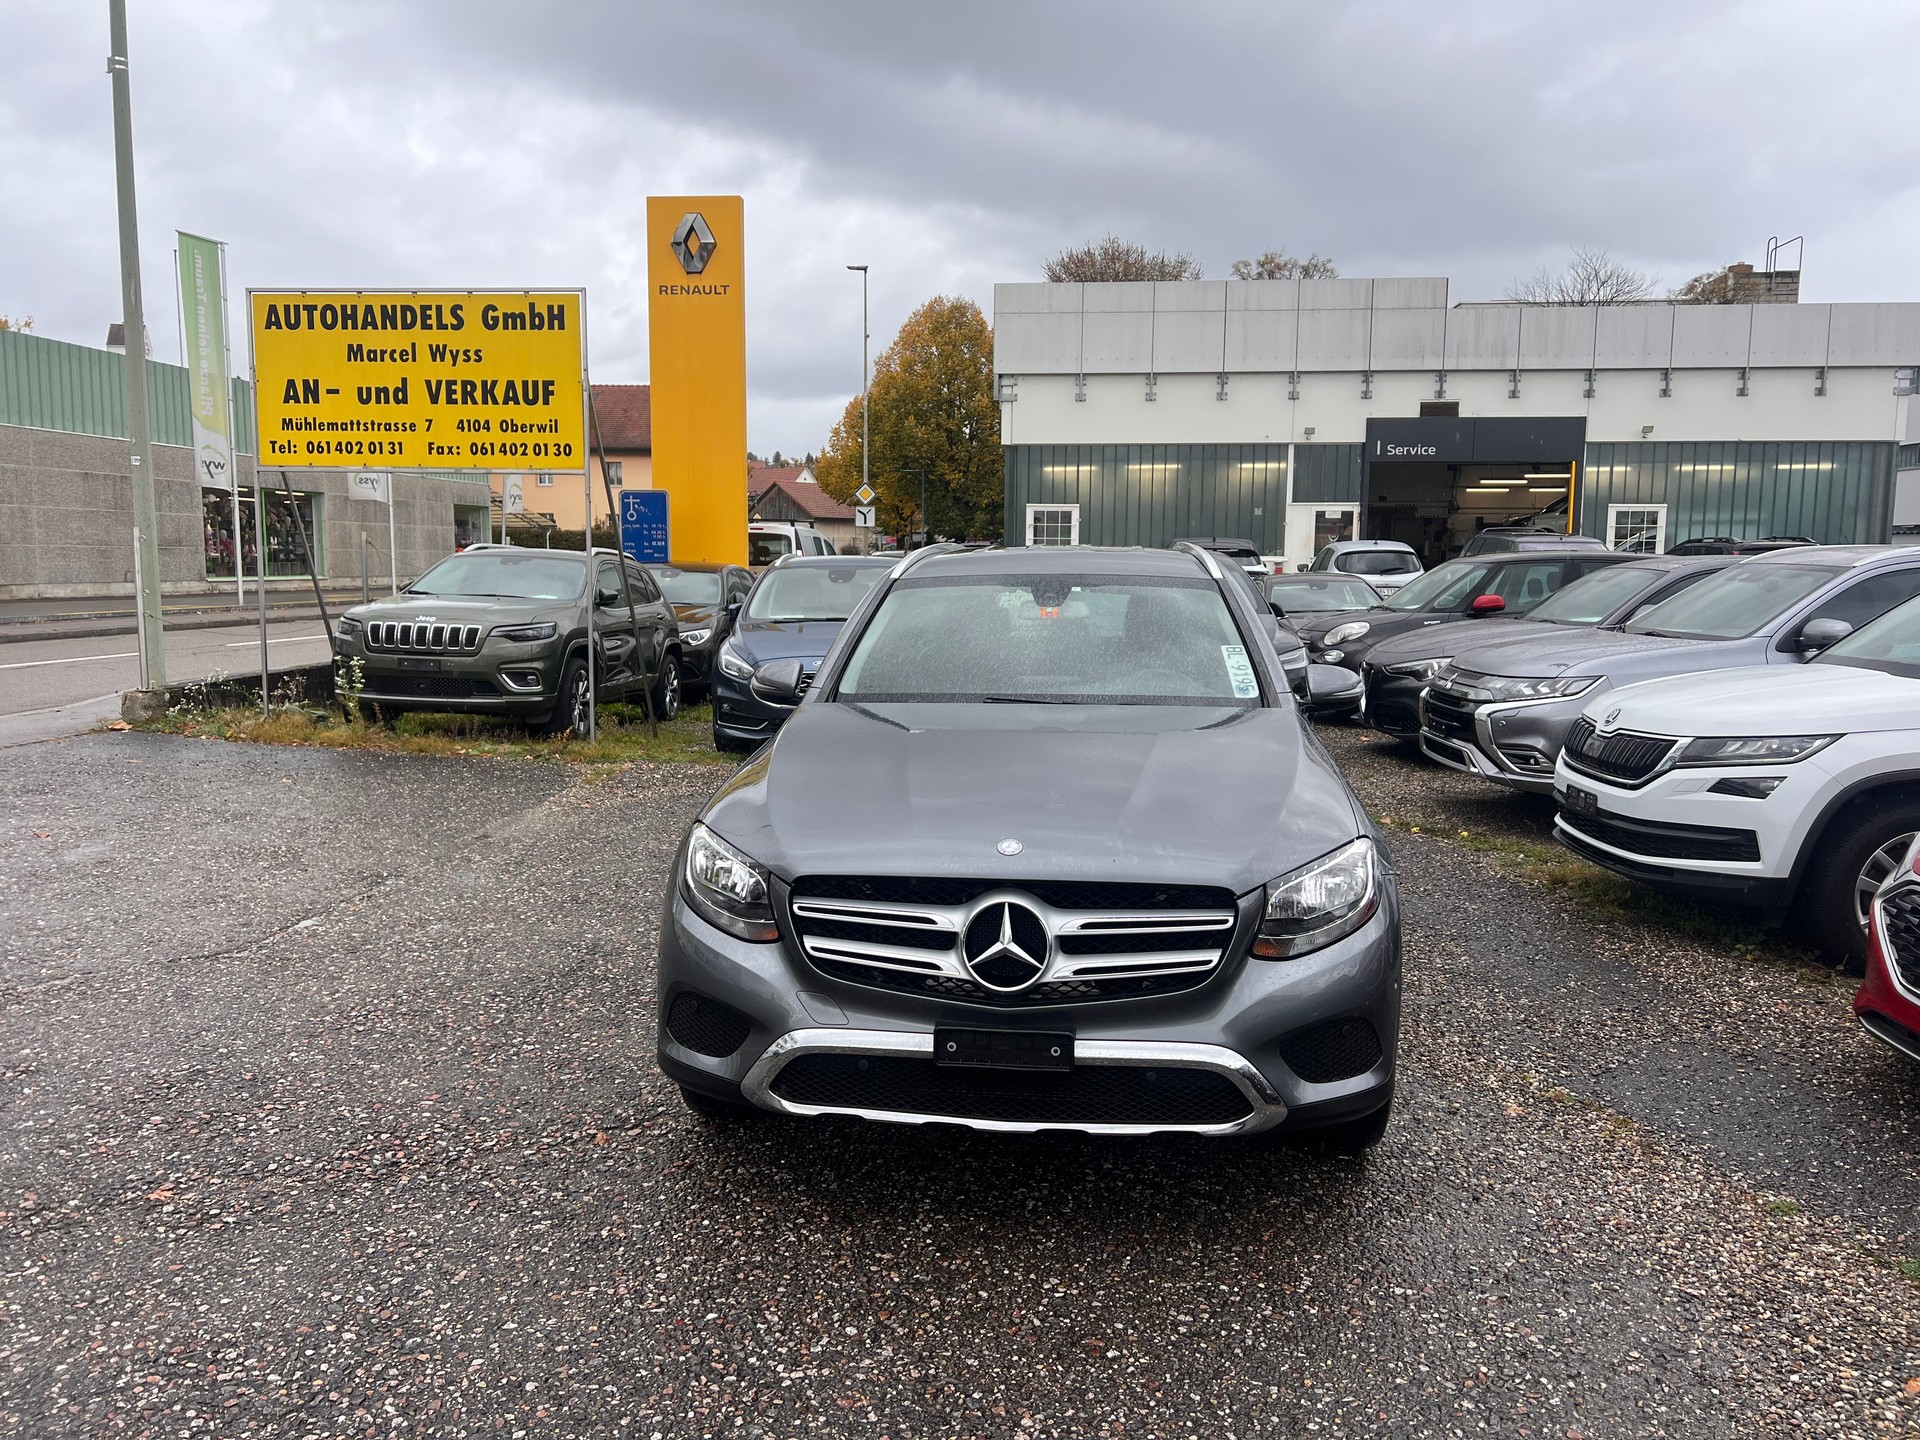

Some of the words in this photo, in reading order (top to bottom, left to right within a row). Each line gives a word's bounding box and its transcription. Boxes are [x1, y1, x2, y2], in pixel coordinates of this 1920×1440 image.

[659, 284, 730, 296] RENAULT
[264, 303, 465, 332] AUTOHANDELS
[481, 302, 566, 331] GmbH
[346, 342, 417, 363] Marcel
[428, 344, 483, 367] Wyss
[357, 377, 408, 405] und
[425, 379, 555, 406] VERKAUF
[281, 417, 417, 433] Mühlemattstrasse
[425, 418, 434, 433] 7
[456, 419, 491, 433] 4104
[499, 418, 559, 434] Oberwil
[269, 439, 298, 455] Tel:
[427, 441, 461, 456] Fax:
[1387, 443, 1436, 455] Service
[415, 614, 437, 623] Jeep
